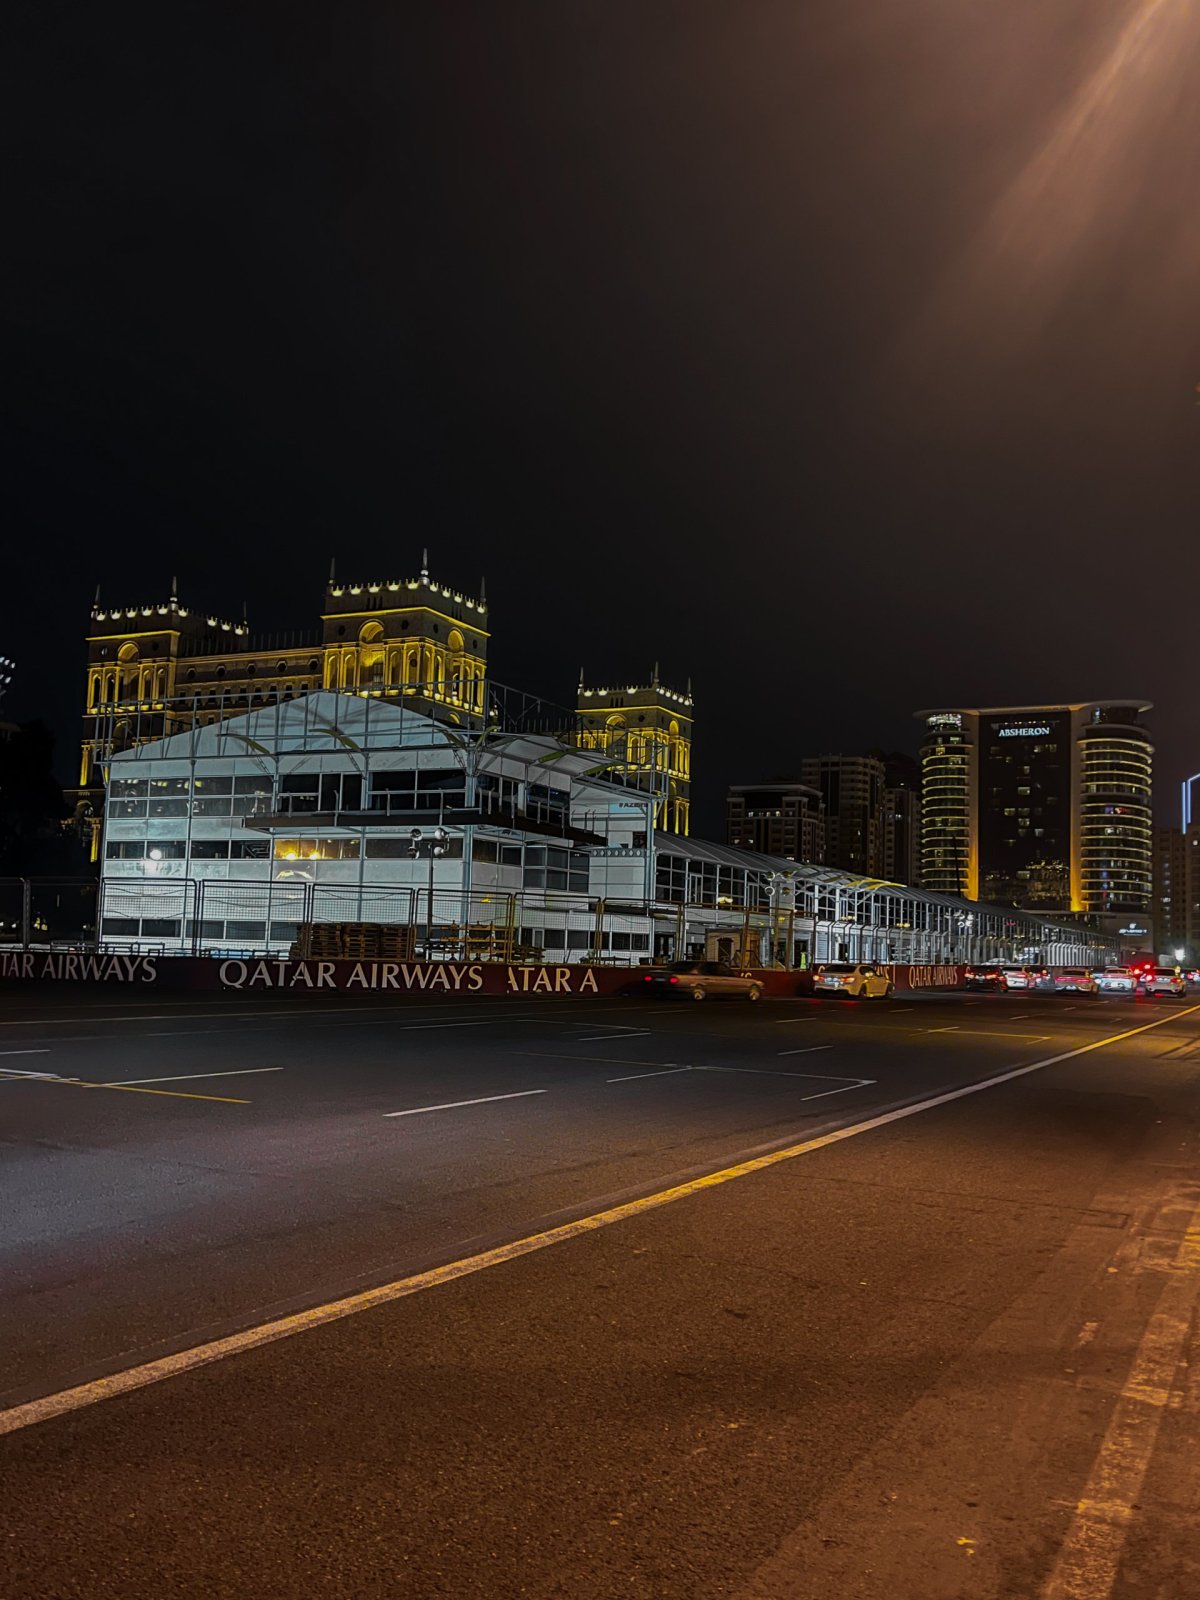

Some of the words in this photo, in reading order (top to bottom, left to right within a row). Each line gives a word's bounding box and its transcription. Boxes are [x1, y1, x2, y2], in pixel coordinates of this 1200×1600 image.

[998, 727, 1050, 737] ABSHERON
[1, 952, 34, 978] TAR
[41, 955, 157, 982] AIRWAYS
[219, 960, 337, 989] QATAR
[346, 962, 483, 990] AIRWAYS
[908, 965, 932, 989] QATAR
[932, 965, 958, 986] AIRWAYS
